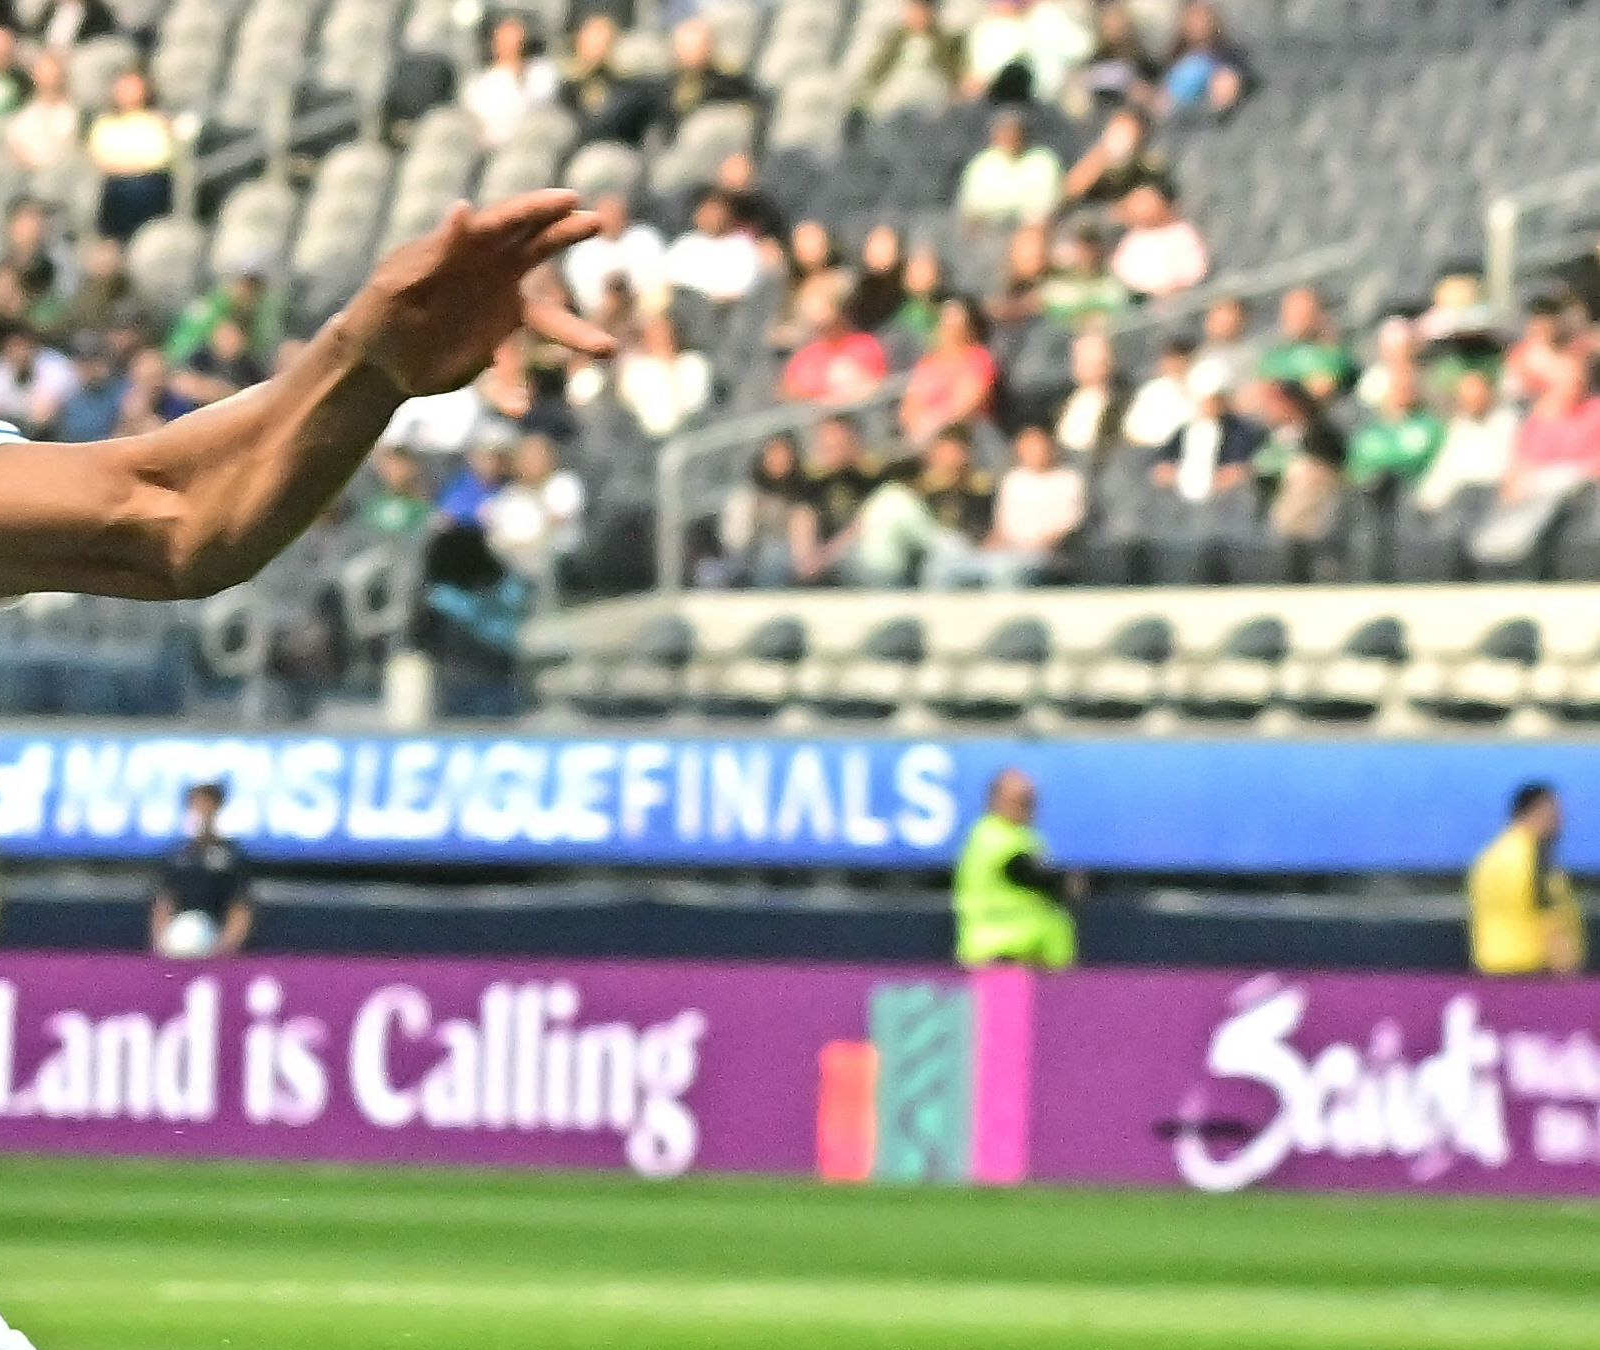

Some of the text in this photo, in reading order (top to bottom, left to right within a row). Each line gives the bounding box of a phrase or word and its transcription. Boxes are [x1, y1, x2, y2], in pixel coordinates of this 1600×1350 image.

[347, 740, 616, 843] LEAGUE
[618, 743, 956, 846] FINALS
[243, 975, 331, 1127] is
[348, 980, 710, 1180] Calling
